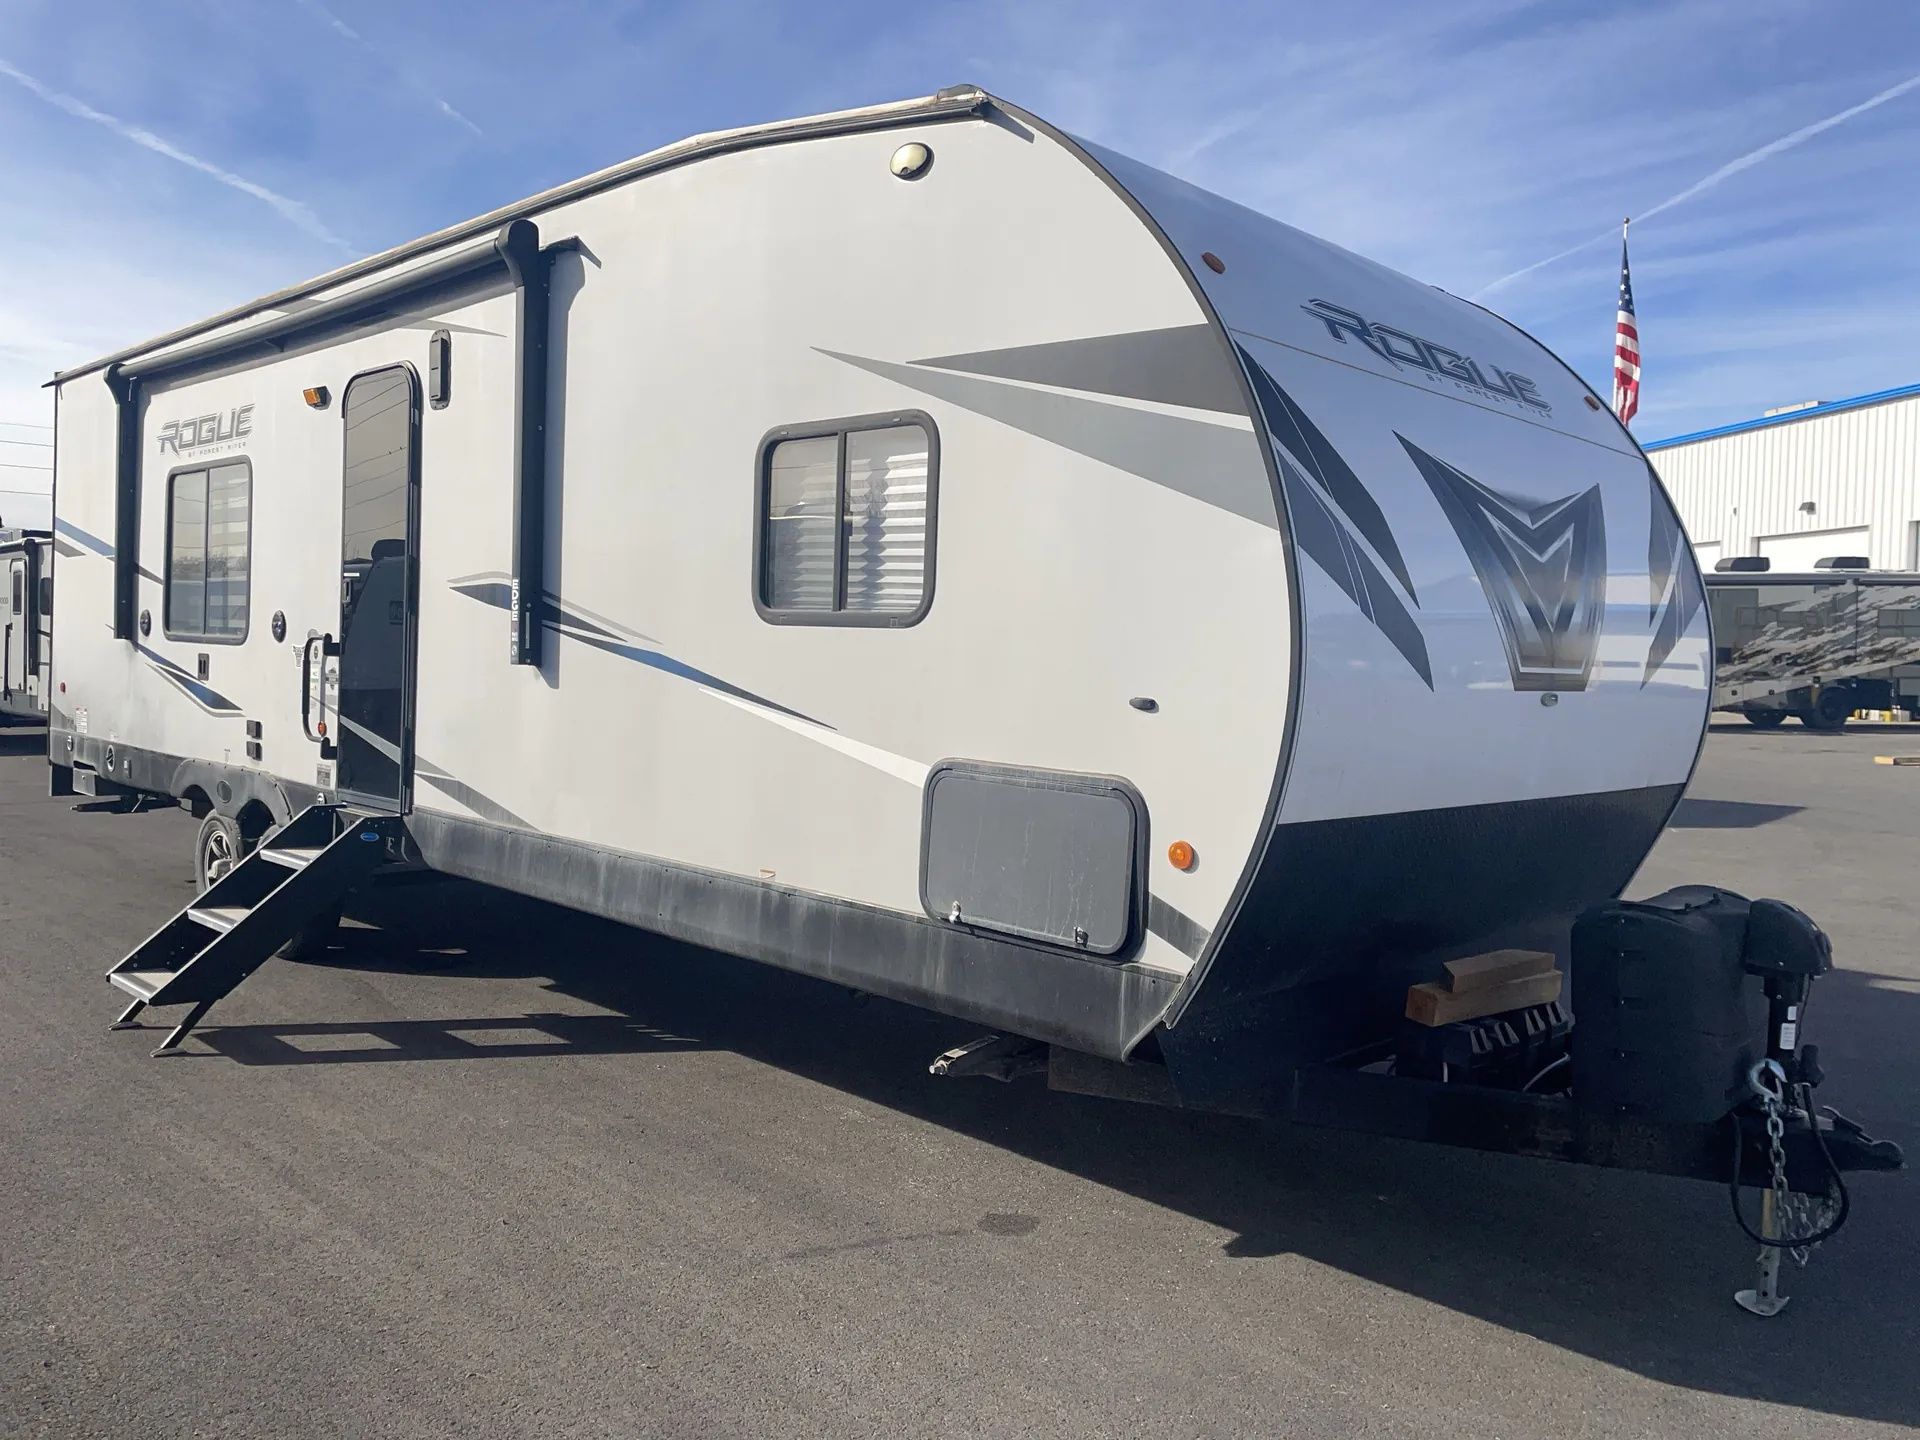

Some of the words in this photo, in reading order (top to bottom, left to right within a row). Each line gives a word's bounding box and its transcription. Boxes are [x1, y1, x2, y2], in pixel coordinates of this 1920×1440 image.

[1300, 298, 1552, 414] ROGUE
[156, 403, 255, 459] ROGUE
[511, 578, 519, 621] EDGE
